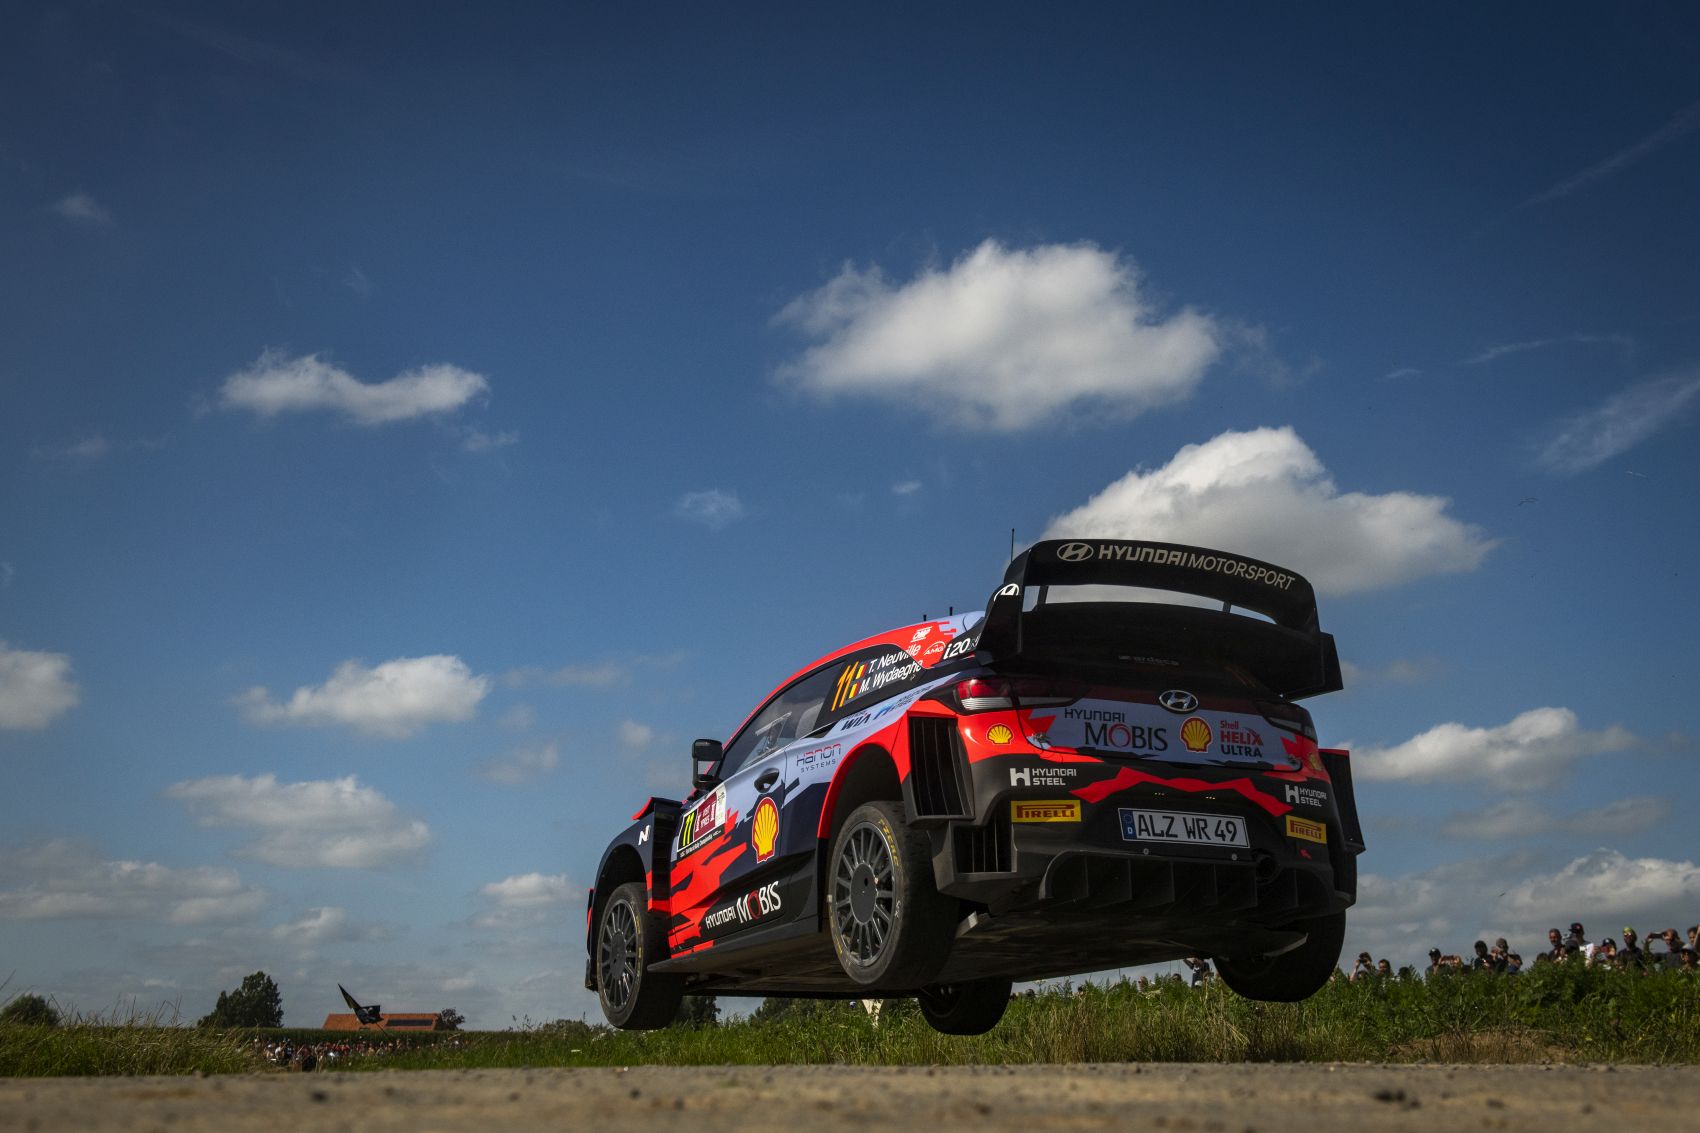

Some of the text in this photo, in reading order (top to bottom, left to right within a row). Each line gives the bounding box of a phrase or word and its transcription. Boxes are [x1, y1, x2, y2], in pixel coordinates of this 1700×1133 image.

[1099, 545, 1296, 591] HYUNDAI MOTORSPORT
[868, 644, 921, 674] T. Neuville
[858, 660, 923, 694] M. Wydaeghe
[831, 661, 859, 711] 11
[841, 713, 871, 731] WIA
[1064, 708, 1125, 723] HYUNDAI
[1220, 720, 1239, 729] Shell
[1085, 722, 1168, 751] MOBIS
[1220, 730, 1264, 746] HELIX
[1220, 744, 1263, 758] ULTRA
[801, 758, 836, 773] SYSTEMS
[1032, 768, 1077, 776] HYUNDAI
[1033, 777, 1066, 786] STEEL
[1300, 788, 1328, 800] HYUNDAI
[1301, 796, 1322, 807] STEEL
[1016, 804, 1075, 818] PIRELLI
[682, 812, 695, 847] 11
[1127, 814, 1238, 842] D ALZ WR 49
[1290, 820, 1322, 840] PIRELLI
[705, 881, 782, 930] HYUNDAI MOBIS
